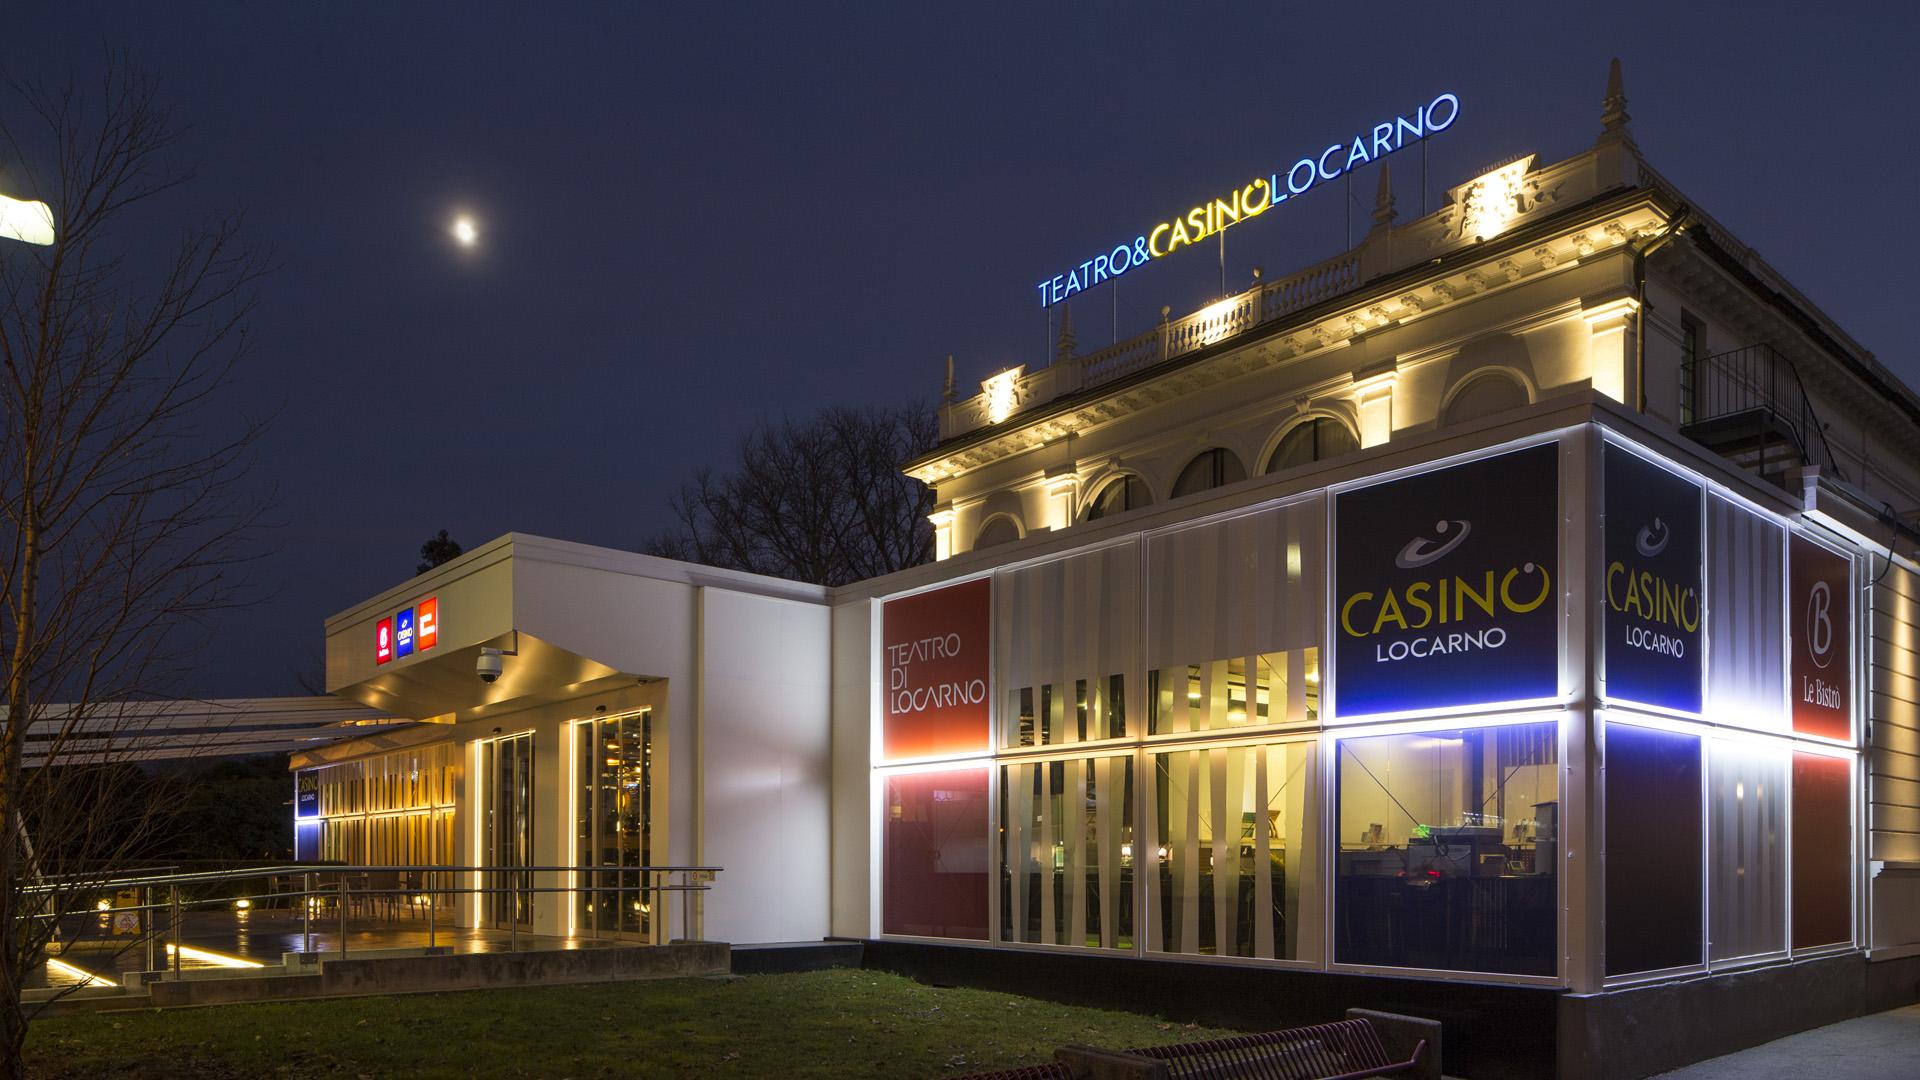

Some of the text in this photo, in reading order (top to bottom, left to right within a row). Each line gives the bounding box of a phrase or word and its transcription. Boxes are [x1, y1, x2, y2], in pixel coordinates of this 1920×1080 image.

[887, 632, 961, 667] TEATRO
[1376, 627, 1507, 663] LOCARNO
[1626, 624, 1684, 659] LOCARNO
[891, 665, 908, 691] DI
[1804, 675, 1841, 710] Le Bistrò
[891, 679, 986, 714] LOCARNO
